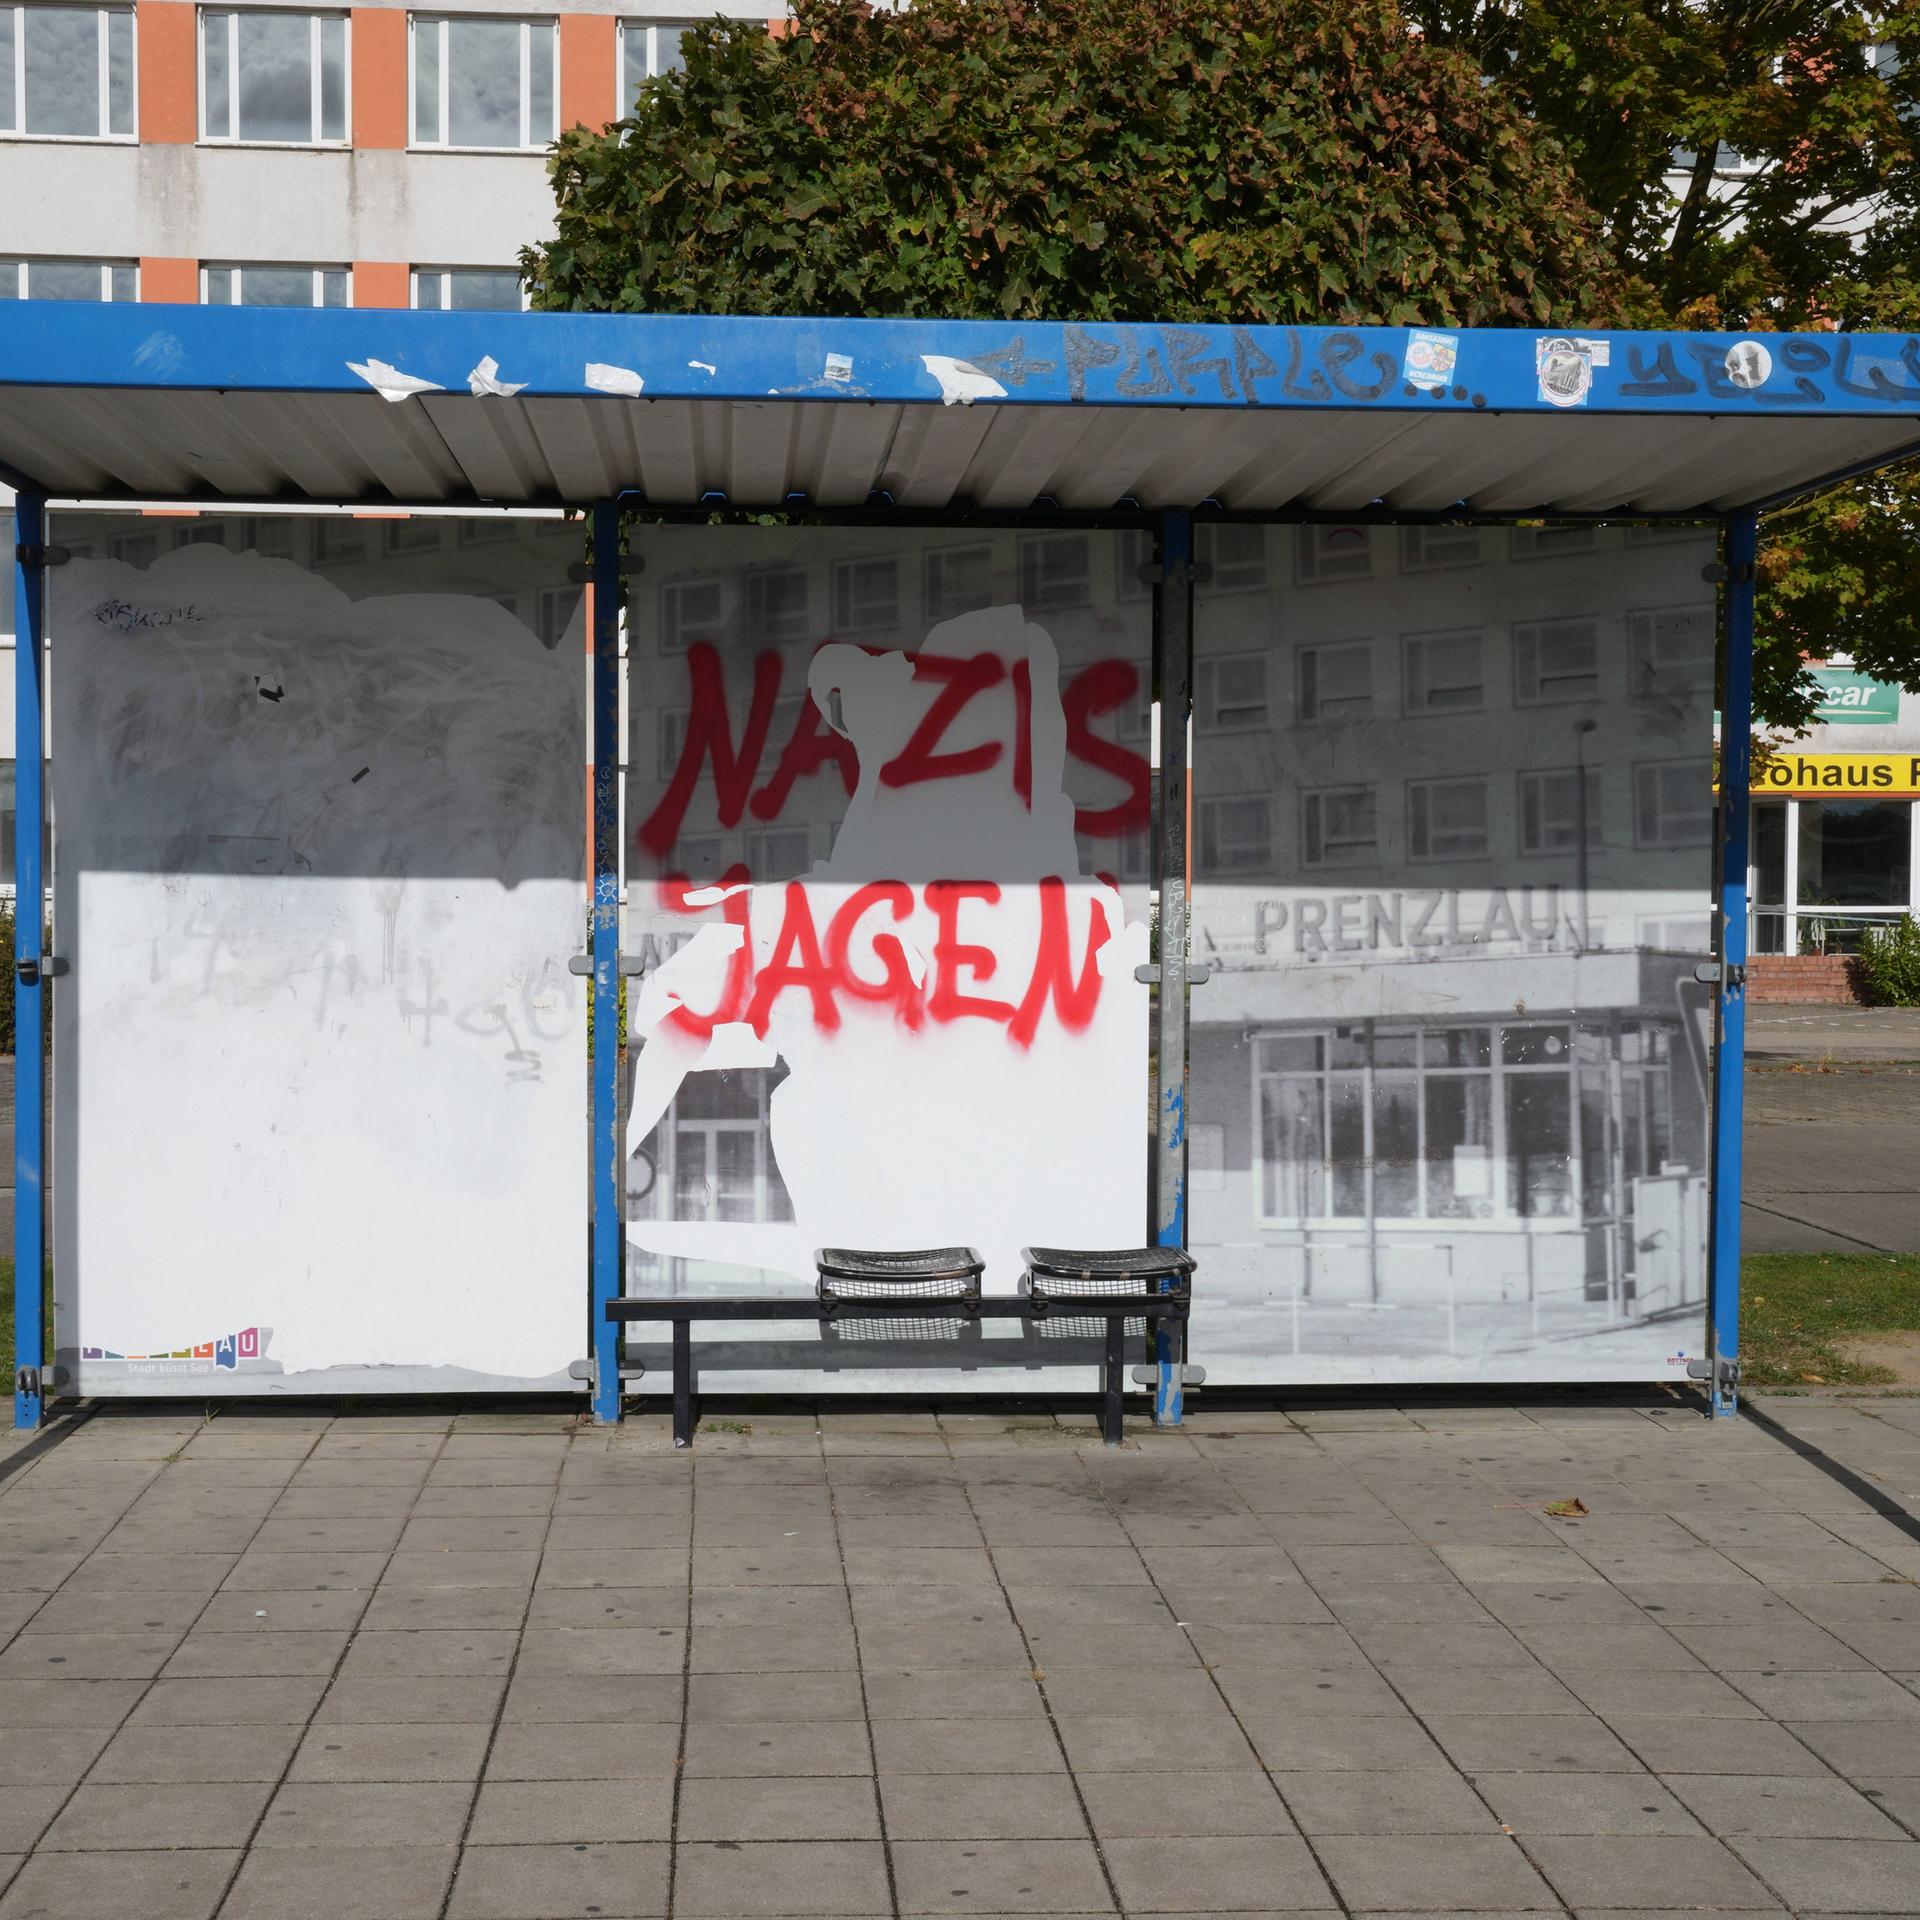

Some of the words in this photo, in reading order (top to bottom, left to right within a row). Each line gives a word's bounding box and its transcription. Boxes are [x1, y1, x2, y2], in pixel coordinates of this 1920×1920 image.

[641, 640, 1150, 862] NAZIS
[1769, 757, 1894, 787] ohaus
[660, 864, 1119, 1052] JAGEN
[1254, 884, 1559, 954] PRENZLAU
